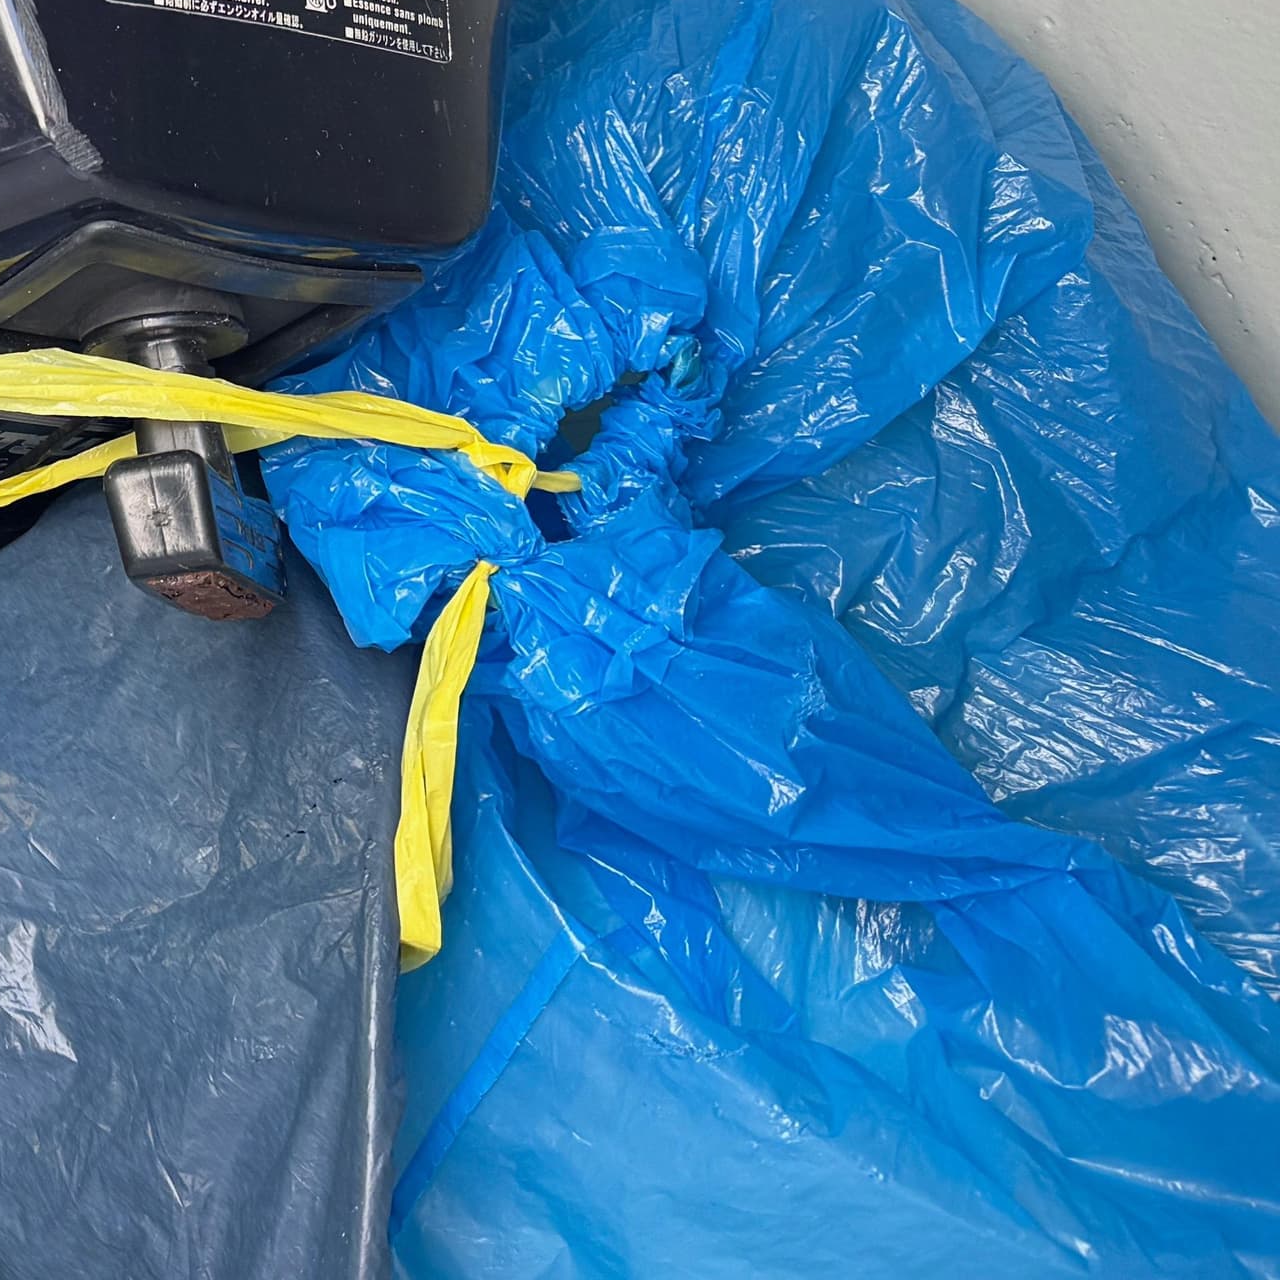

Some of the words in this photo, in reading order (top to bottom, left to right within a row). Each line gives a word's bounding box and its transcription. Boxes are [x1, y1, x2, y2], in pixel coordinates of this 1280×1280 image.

[353, 13, 412, 35] uniquement.
[394, 7, 415, 21] sans
[418, 13, 444, 28] plomb
